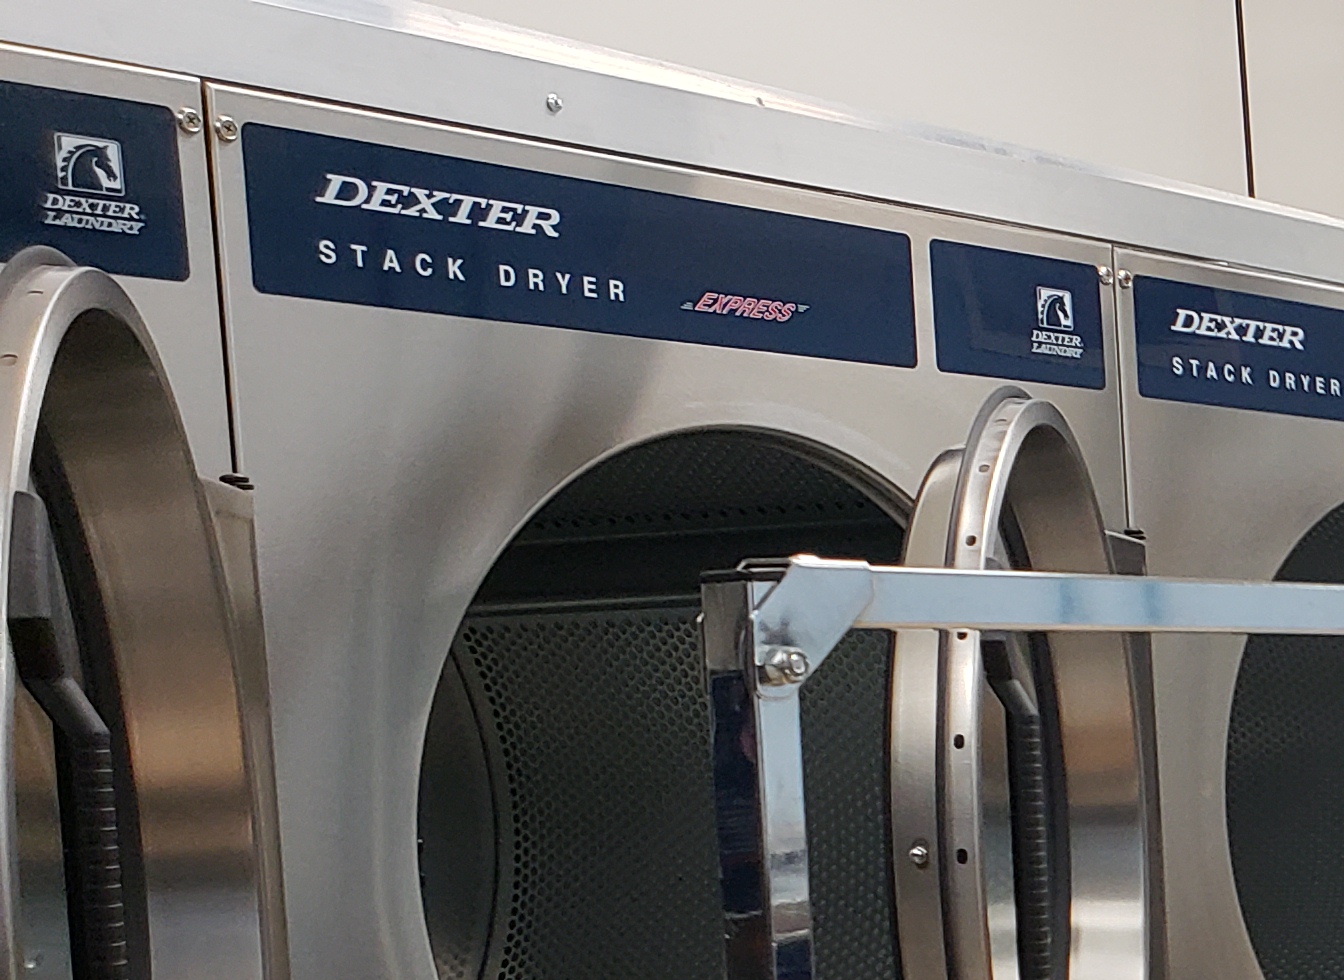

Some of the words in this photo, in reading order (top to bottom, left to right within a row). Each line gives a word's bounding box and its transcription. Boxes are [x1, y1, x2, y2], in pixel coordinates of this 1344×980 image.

[44, 192, 143, 220] DEXTER
[44, 210, 145, 235] LAUNDRY
[315, 173, 562, 239] DEXTER
[318, 240, 466, 282] STACK
[499, 263, 626, 303] DRYER
[695, 291, 797, 324] EXPRESS
[1032, 329, 1083, 349] DEXTER
[1170, 308, 1305, 351] DEXTER
[1031, 342, 1084, 360] LAUNDRY
[1172, 356, 1254, 385] STACK
[1269, 369, 1343, 397] DRYER
